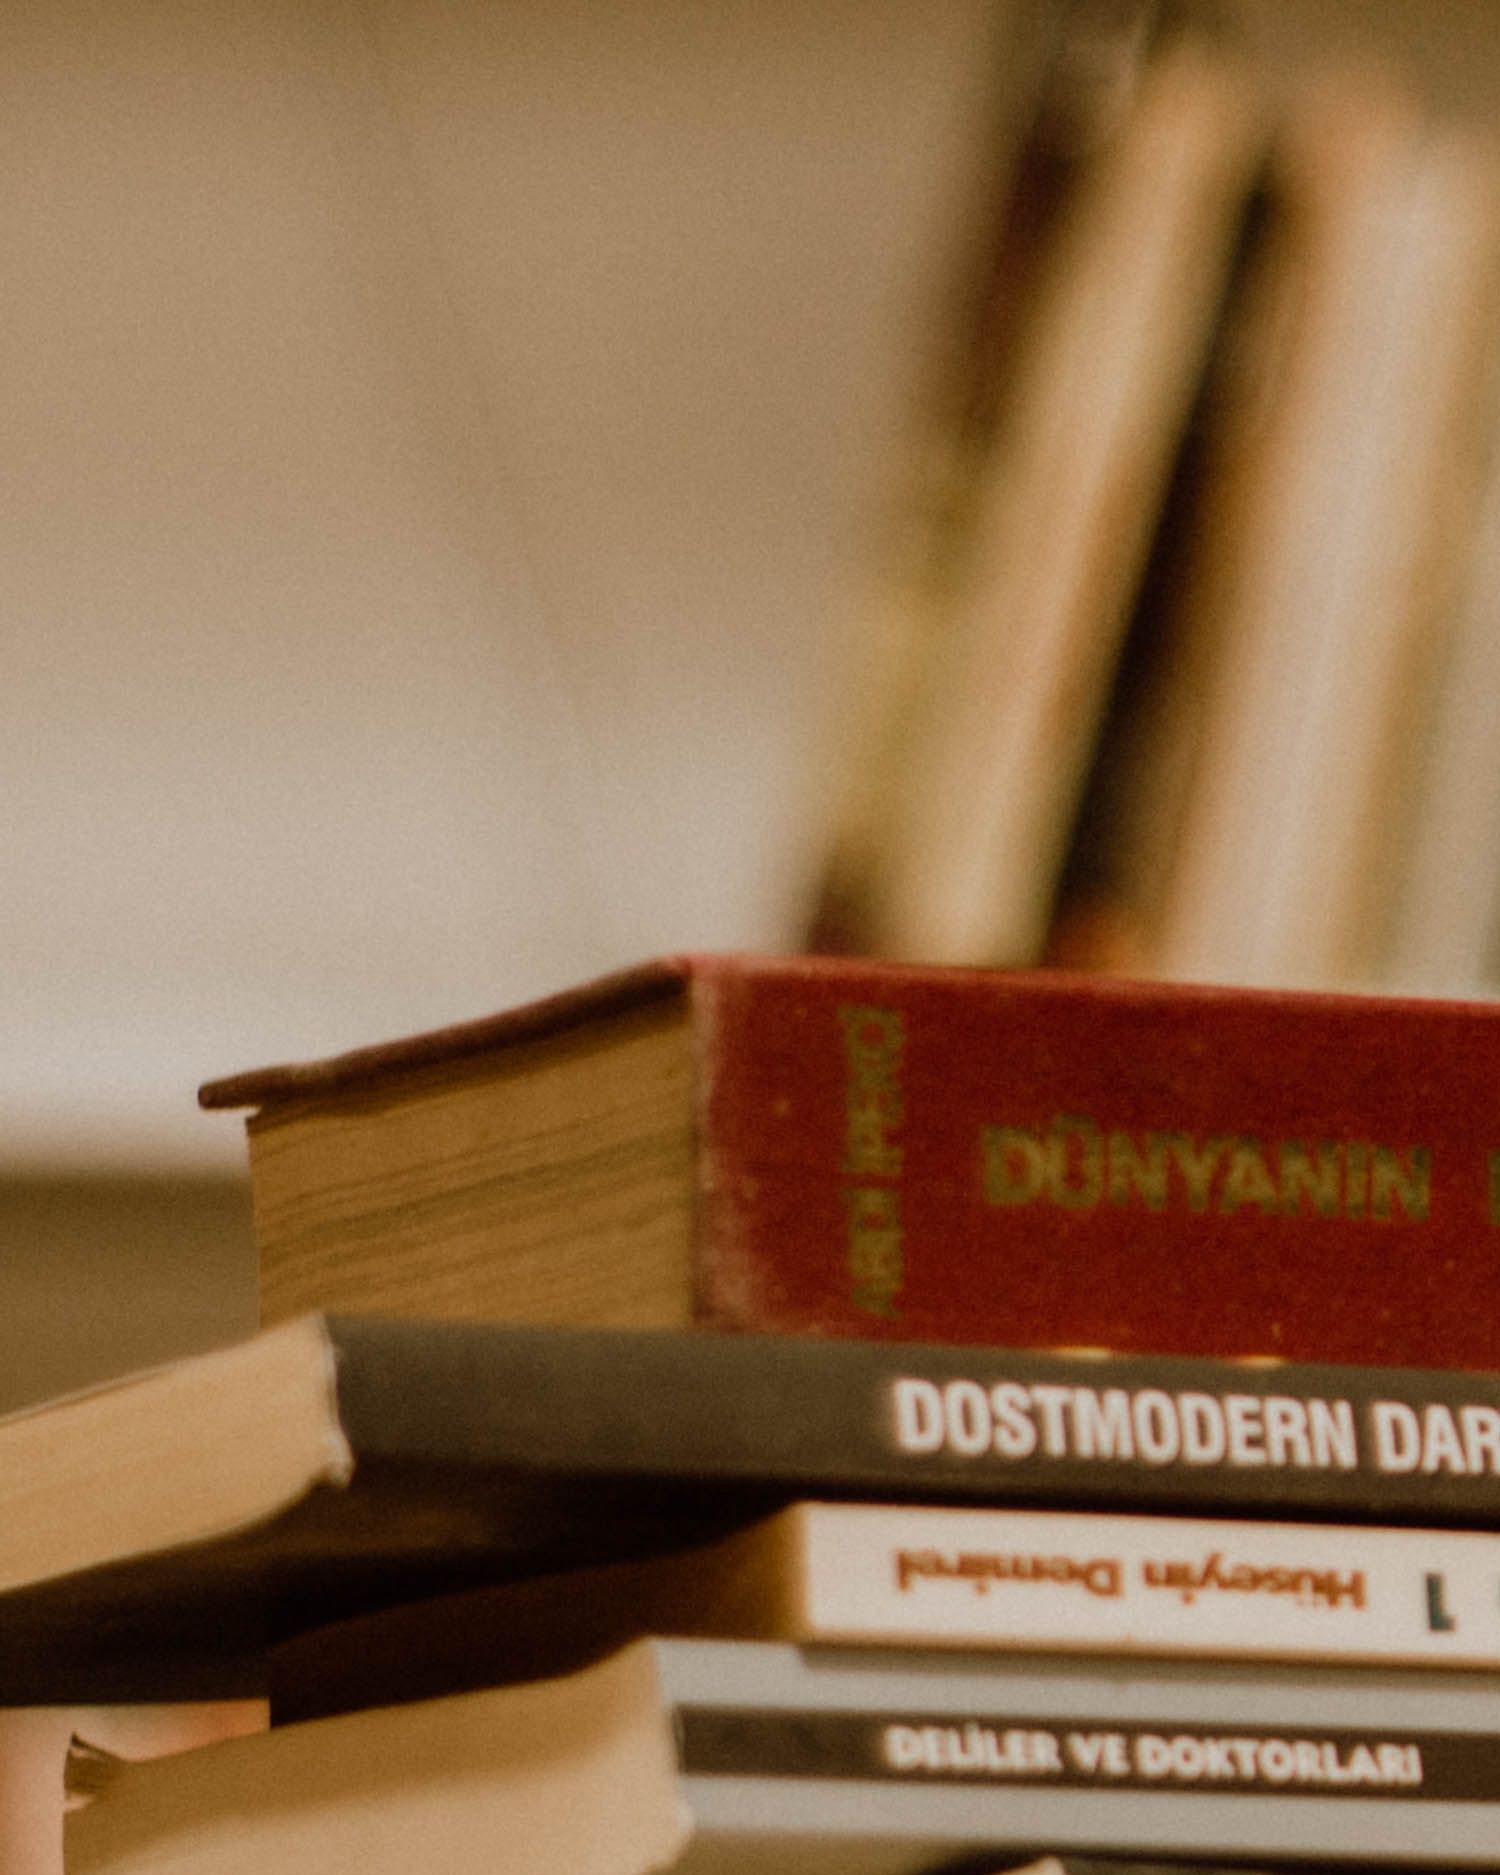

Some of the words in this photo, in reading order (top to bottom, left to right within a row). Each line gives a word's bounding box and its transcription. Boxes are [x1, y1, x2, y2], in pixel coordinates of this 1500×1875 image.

[980, 1113, 1431, 1221] DÜNYANIN
[891, 1378, 1356, 1468] DOSTMODERN
[895, 1551, 1121, 1597] Demirel
[1142, 1554, 1365, 1608] Hüseyin
[1425, 1573, 1454, 1633] 1
[885, 1726, 1060, 1771] DELİLER
[1070, 1734, 1130, 1775] VE
[1137, 1733, 1423, 1787] DOKTORLARI
